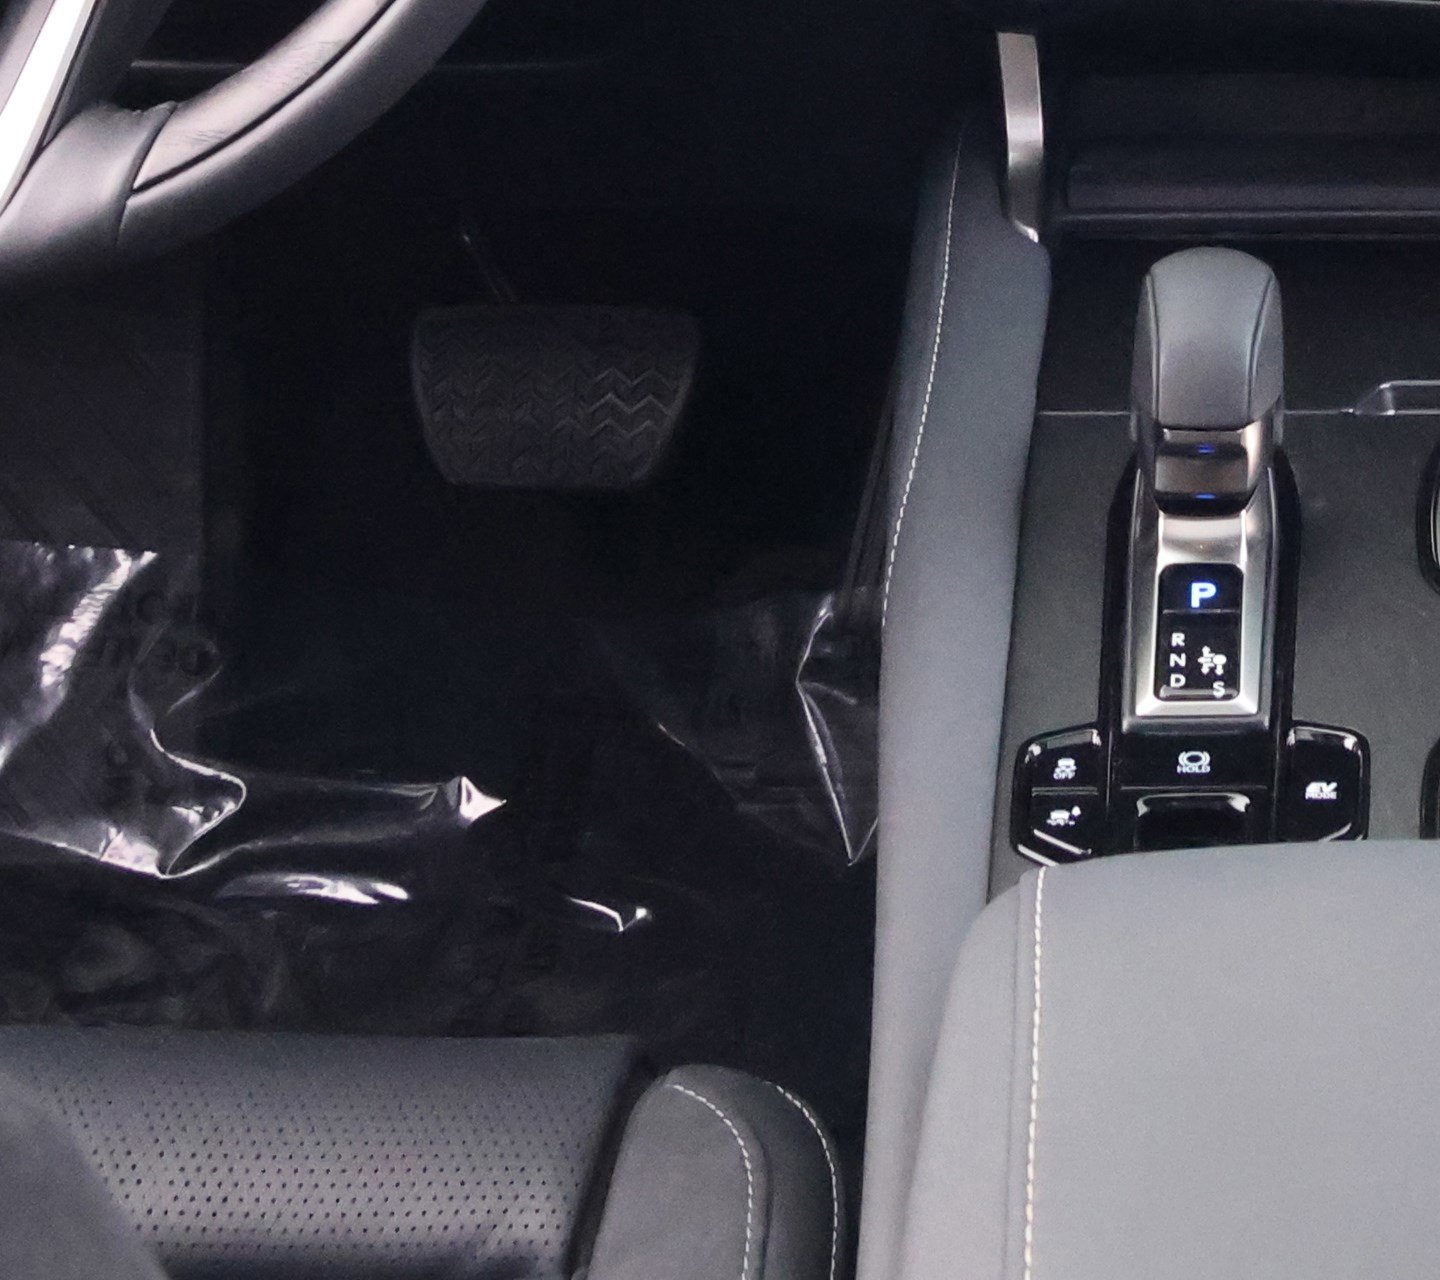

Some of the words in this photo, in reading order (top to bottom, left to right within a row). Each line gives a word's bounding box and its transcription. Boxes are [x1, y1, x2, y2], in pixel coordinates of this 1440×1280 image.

[1189, 582, 1217, 609] P
[1171, 632, 1186, 648] R
[1169, 653, 1187, 668] N
[1170, 673, 1187, 688] D
[1212, 680, 1226, 699] S
[1053, 770, 1076, 780] OFF
[1176, 765, 1211, 774] HOLD
[1305, 791, 1338, 801] MODE
